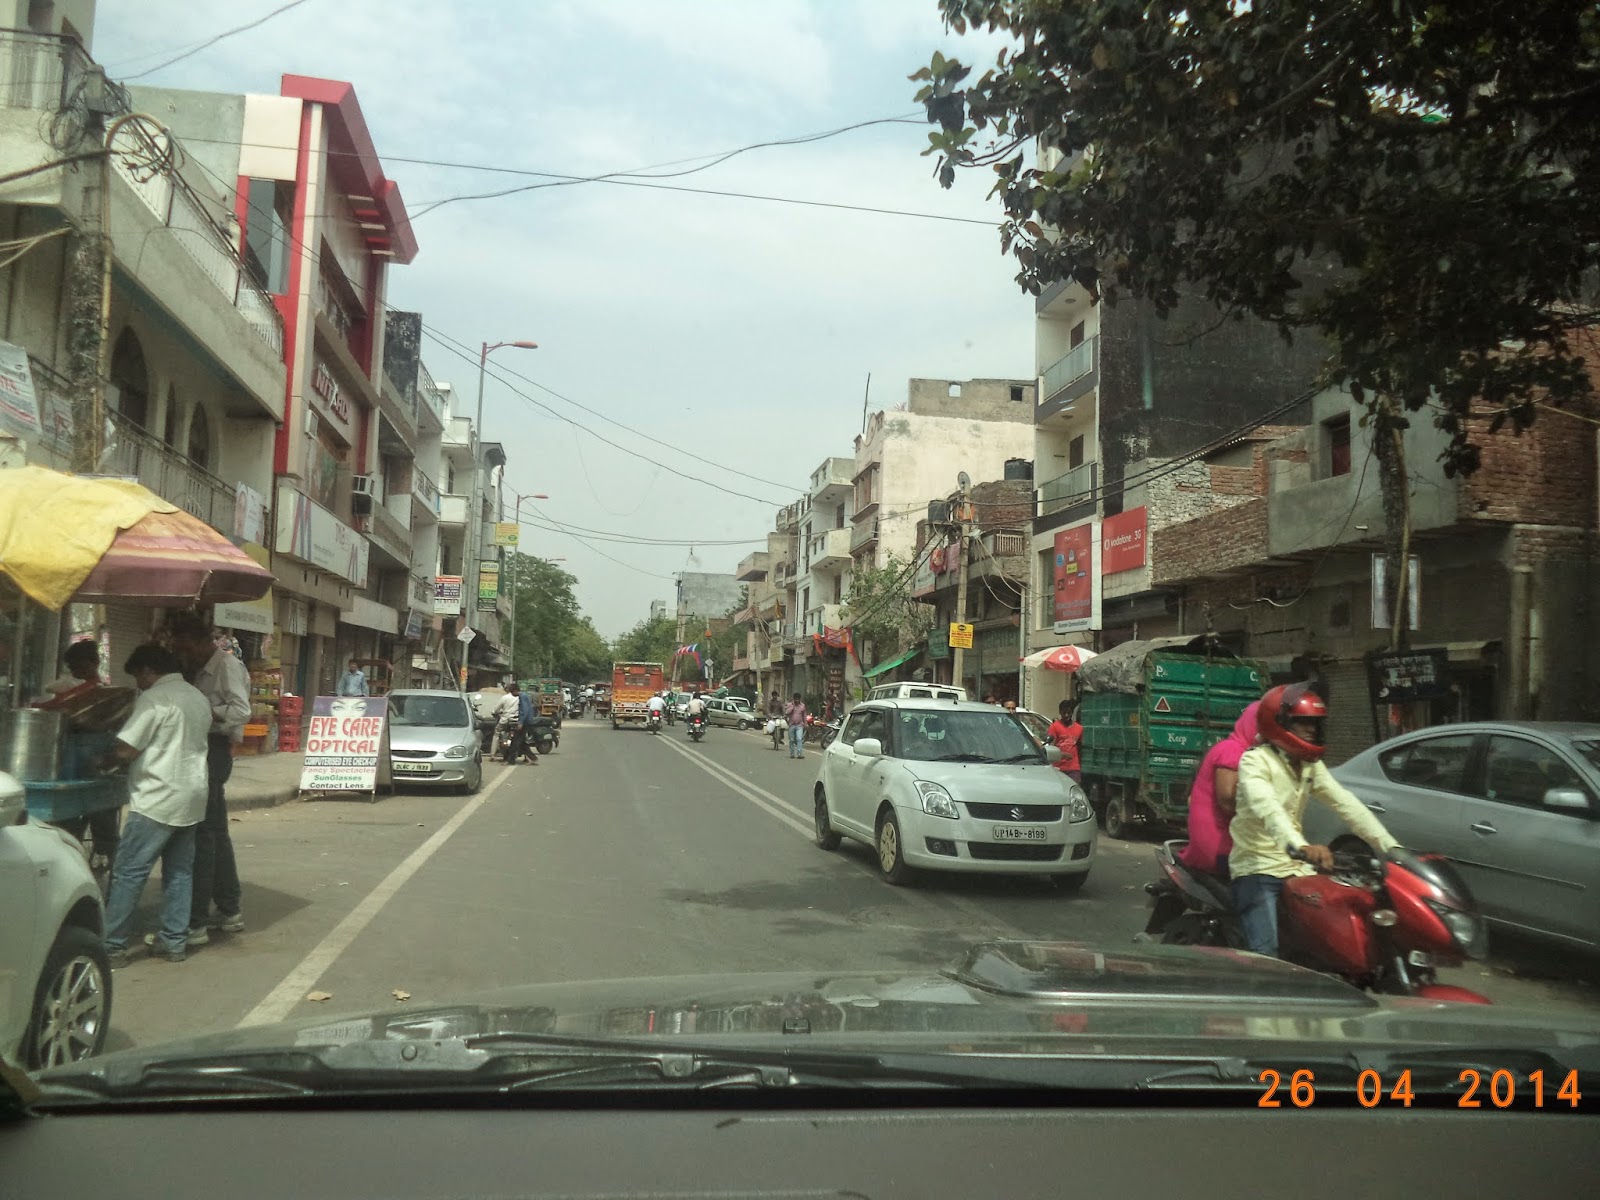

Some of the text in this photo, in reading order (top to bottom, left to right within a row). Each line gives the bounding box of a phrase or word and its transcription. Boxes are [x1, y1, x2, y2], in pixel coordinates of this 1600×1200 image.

[1110, 529, 1142, 547] vodafone 3G
[310, 717, 380, 738] EYE CARE
[1168, 733, 1187, 745] Keep
[307, 739, 377, 754] OPTICAL
[342, 757, 353, 766] EYE
[303, 766, 376, 775] Fancy Spectacles
